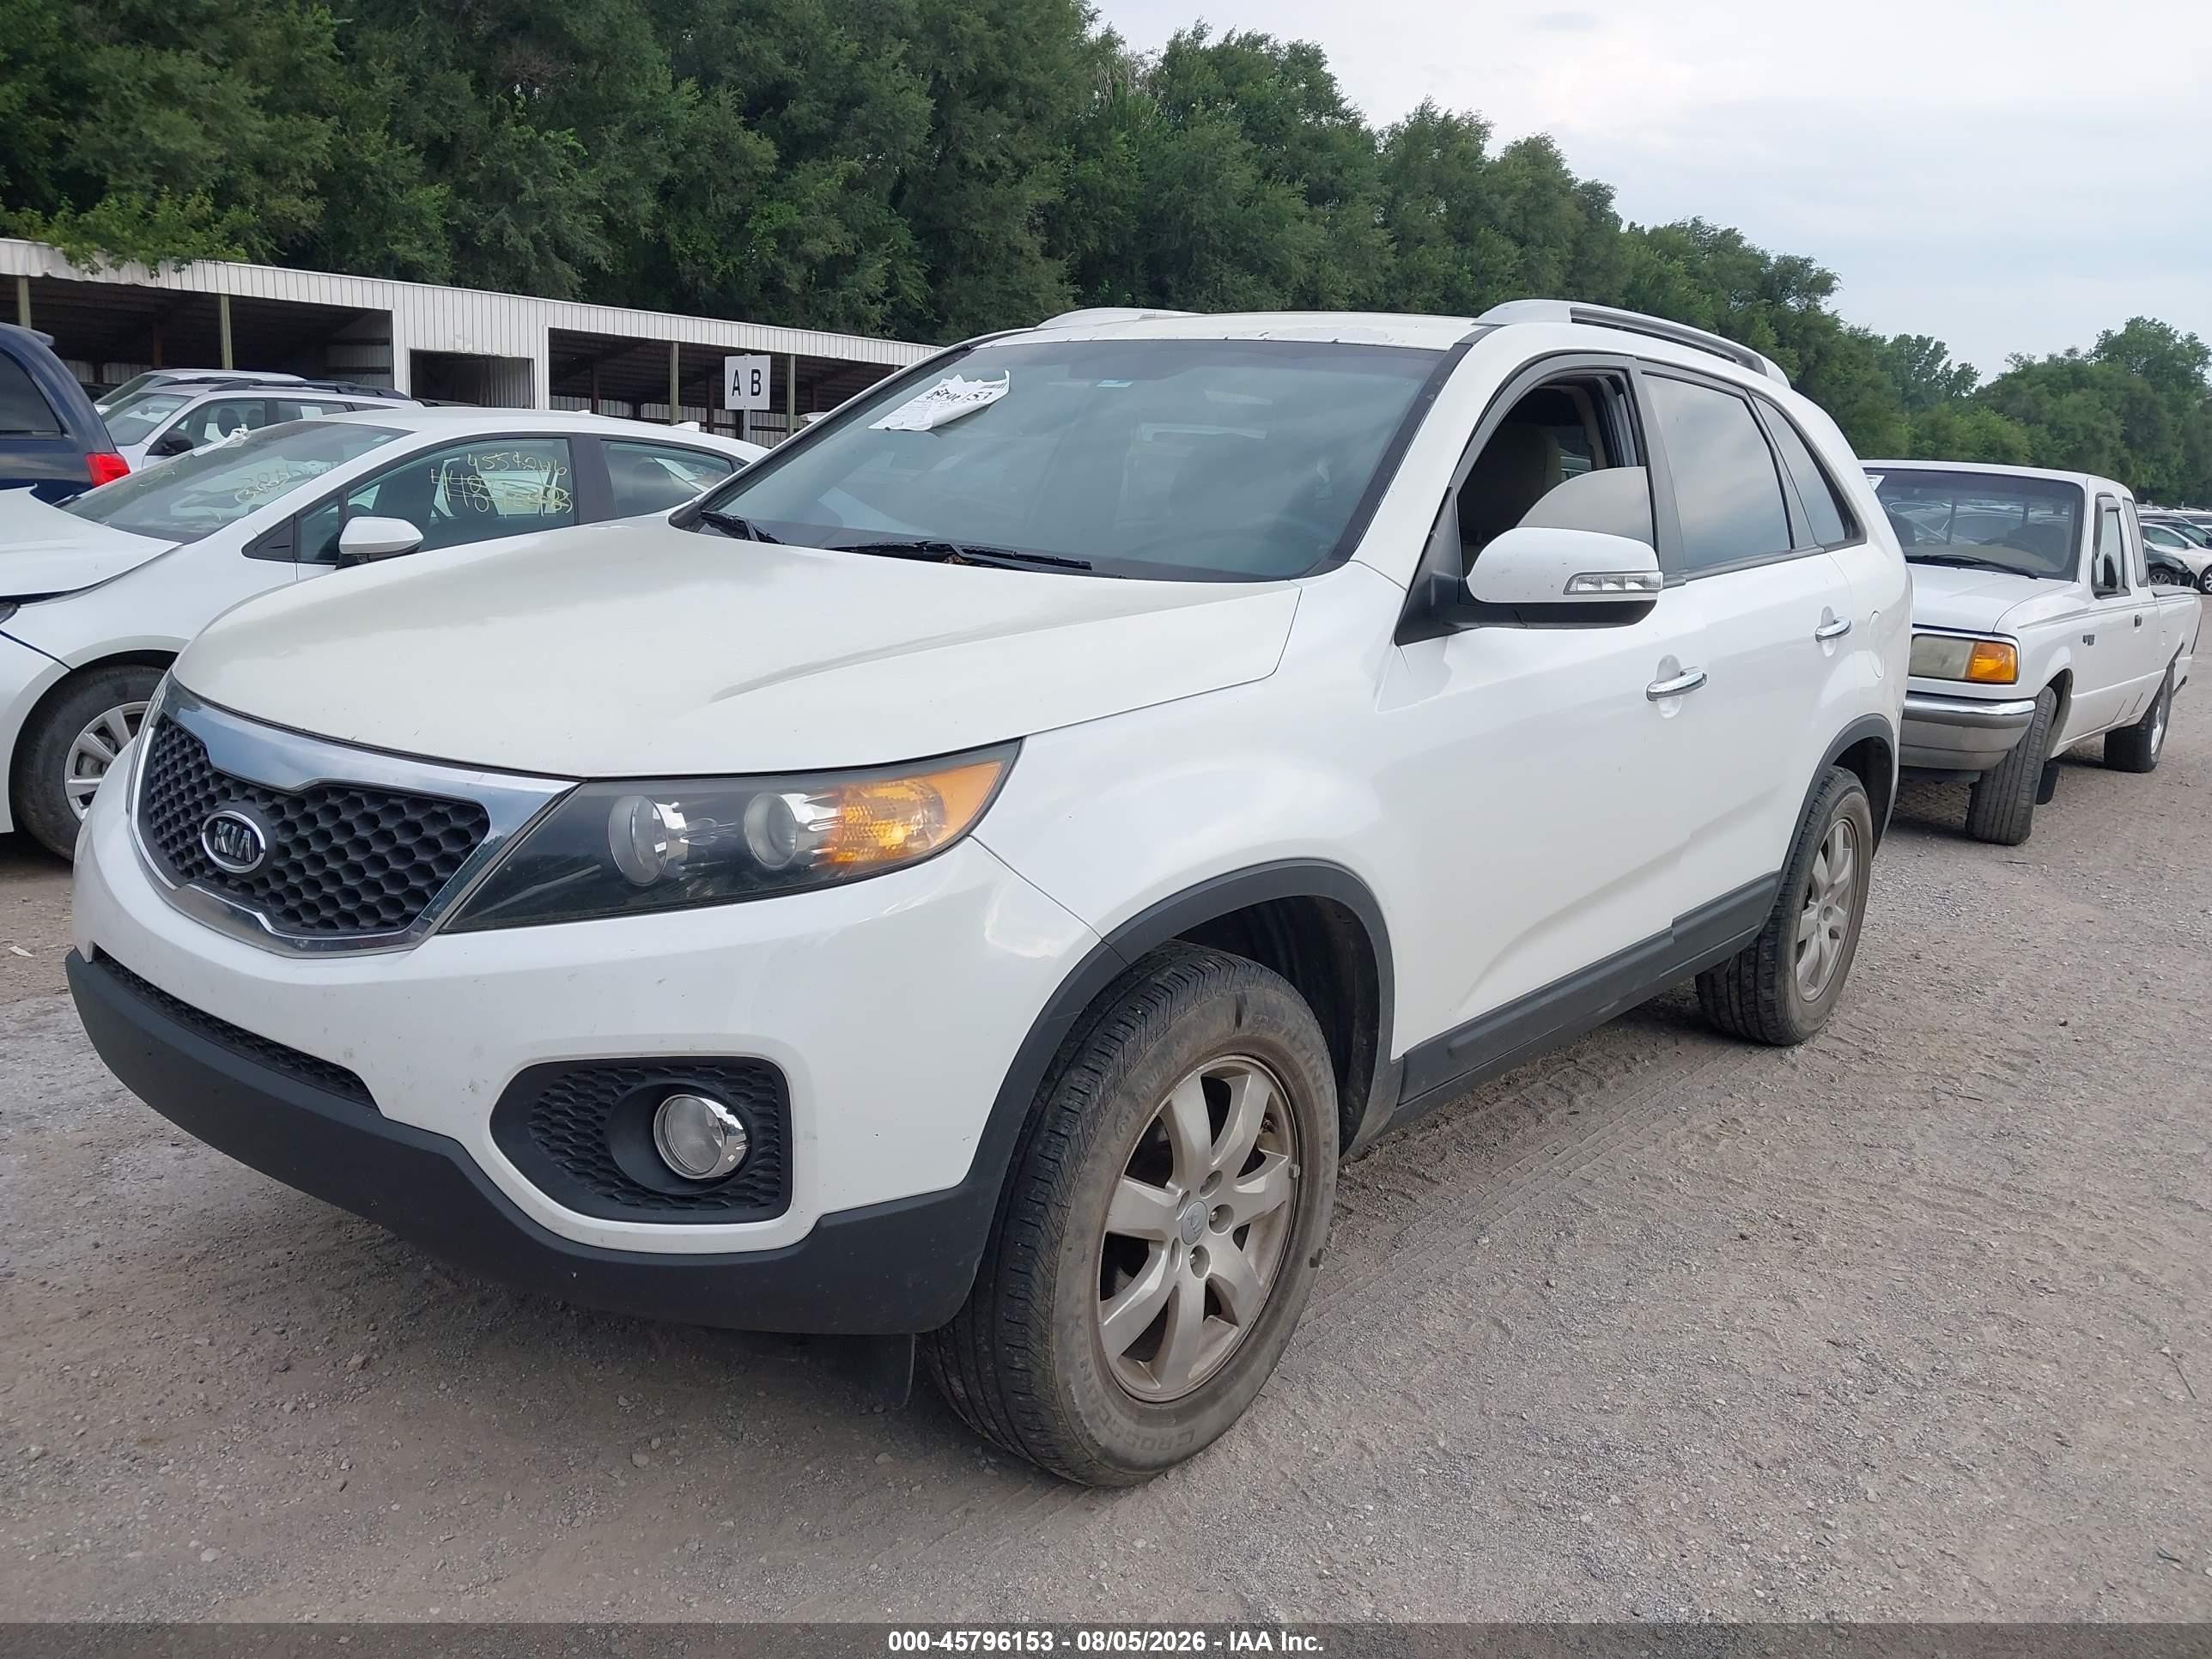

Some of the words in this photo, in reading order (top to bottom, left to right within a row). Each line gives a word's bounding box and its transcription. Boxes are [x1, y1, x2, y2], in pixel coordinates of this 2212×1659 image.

[732, 369, 741, 396] A
[750, 368, 762, 396] B
[214, 820, 255, 862] KIA
